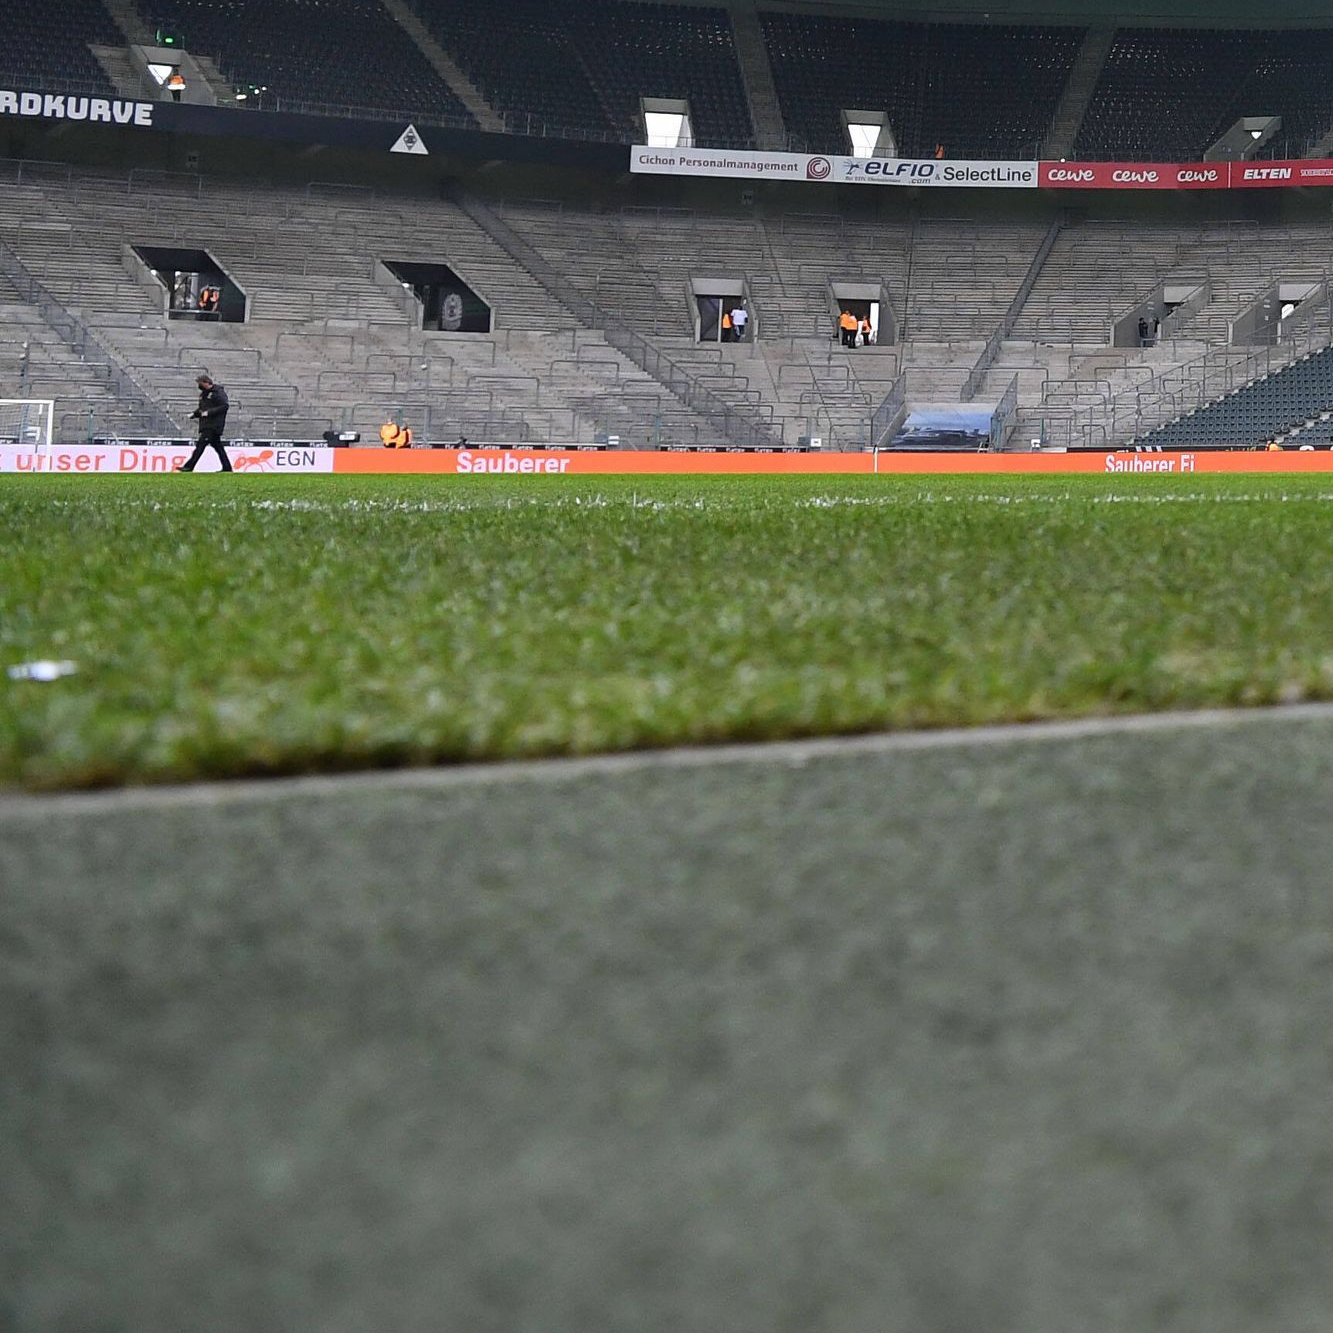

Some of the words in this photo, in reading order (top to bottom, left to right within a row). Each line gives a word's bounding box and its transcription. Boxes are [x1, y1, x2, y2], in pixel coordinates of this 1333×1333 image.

[639, 154, 675, 166] Cichon
[679, 157, 799, 173] Personalmanagement
[943, 166, 1031, 182] SelectLine
[1048, 169, 1095, 182] cewe
[1112, 169, 1160, 183] cewe
[1177, 169, 1218, 182] cewe
[1243, 168, 1292, 180] ELTEN
[276, 450, 316, 466] EGN
[456, 451, 570, 473] Sauberer
[1105, 454, 1175, 472] Sauberer
